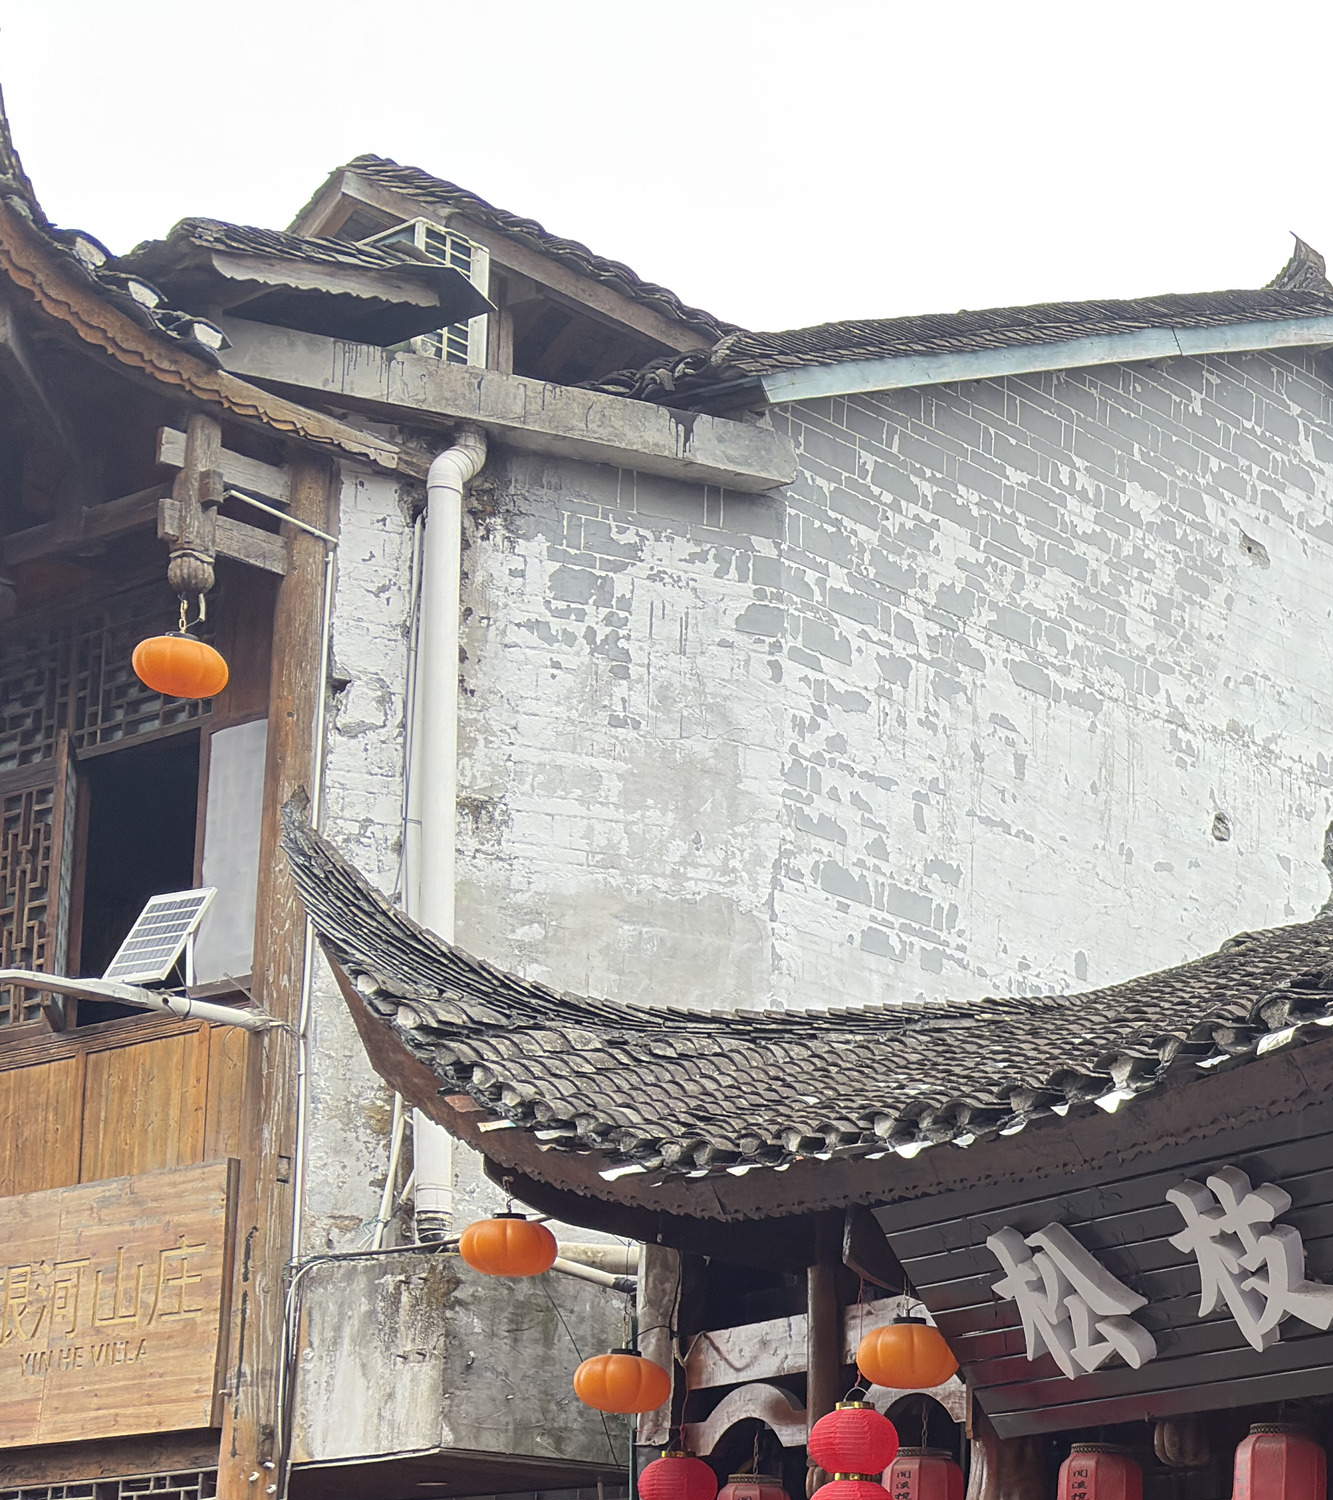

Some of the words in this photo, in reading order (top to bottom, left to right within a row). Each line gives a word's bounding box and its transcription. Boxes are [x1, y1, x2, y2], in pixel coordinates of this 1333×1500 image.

[20, 1350, 53, 1376] YIN
[58, 1347, 84, 1371] HE
[91, 1339, 146, 1367] VILLA
